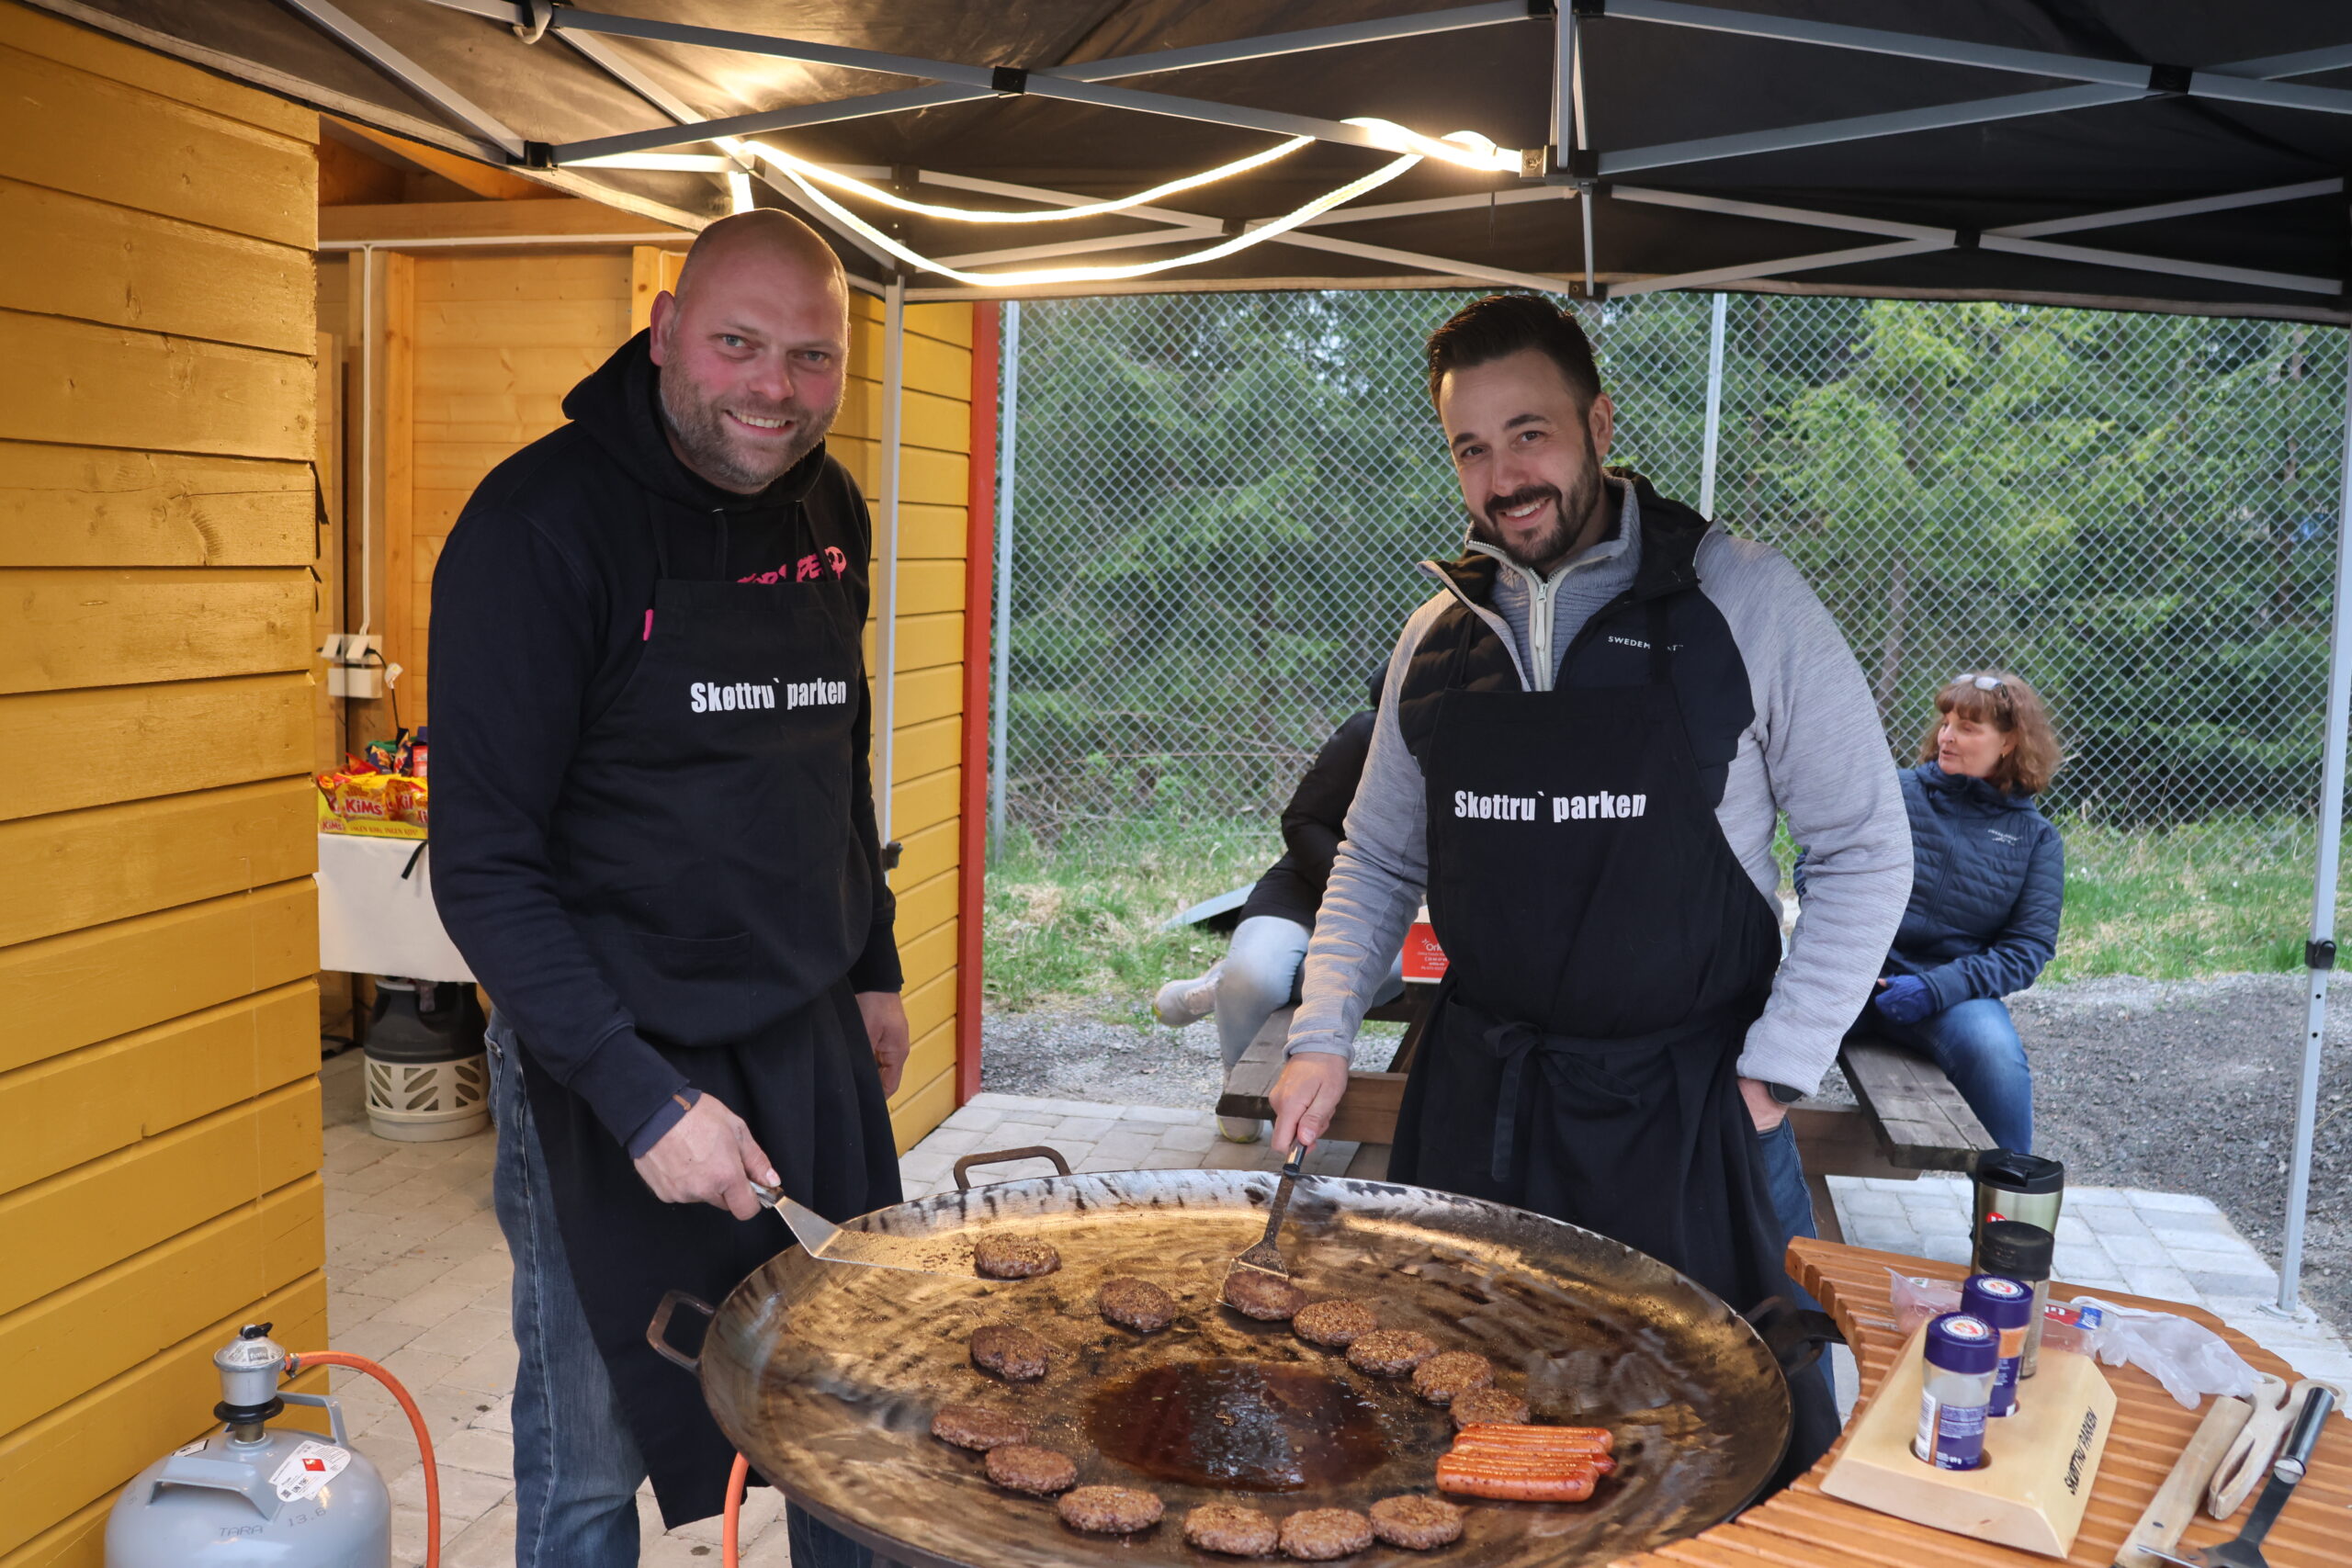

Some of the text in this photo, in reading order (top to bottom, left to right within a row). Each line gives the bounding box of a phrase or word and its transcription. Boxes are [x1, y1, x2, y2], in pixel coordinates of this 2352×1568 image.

[786, 678, 846, 711] parken
[345, 798, 383, 816] KiMs
[1553, 790, 1647, 823] parken
[2078, 1405, 2098, 1451] PARKEN
[220, 1506, 327, 1538] TARA 13.6
